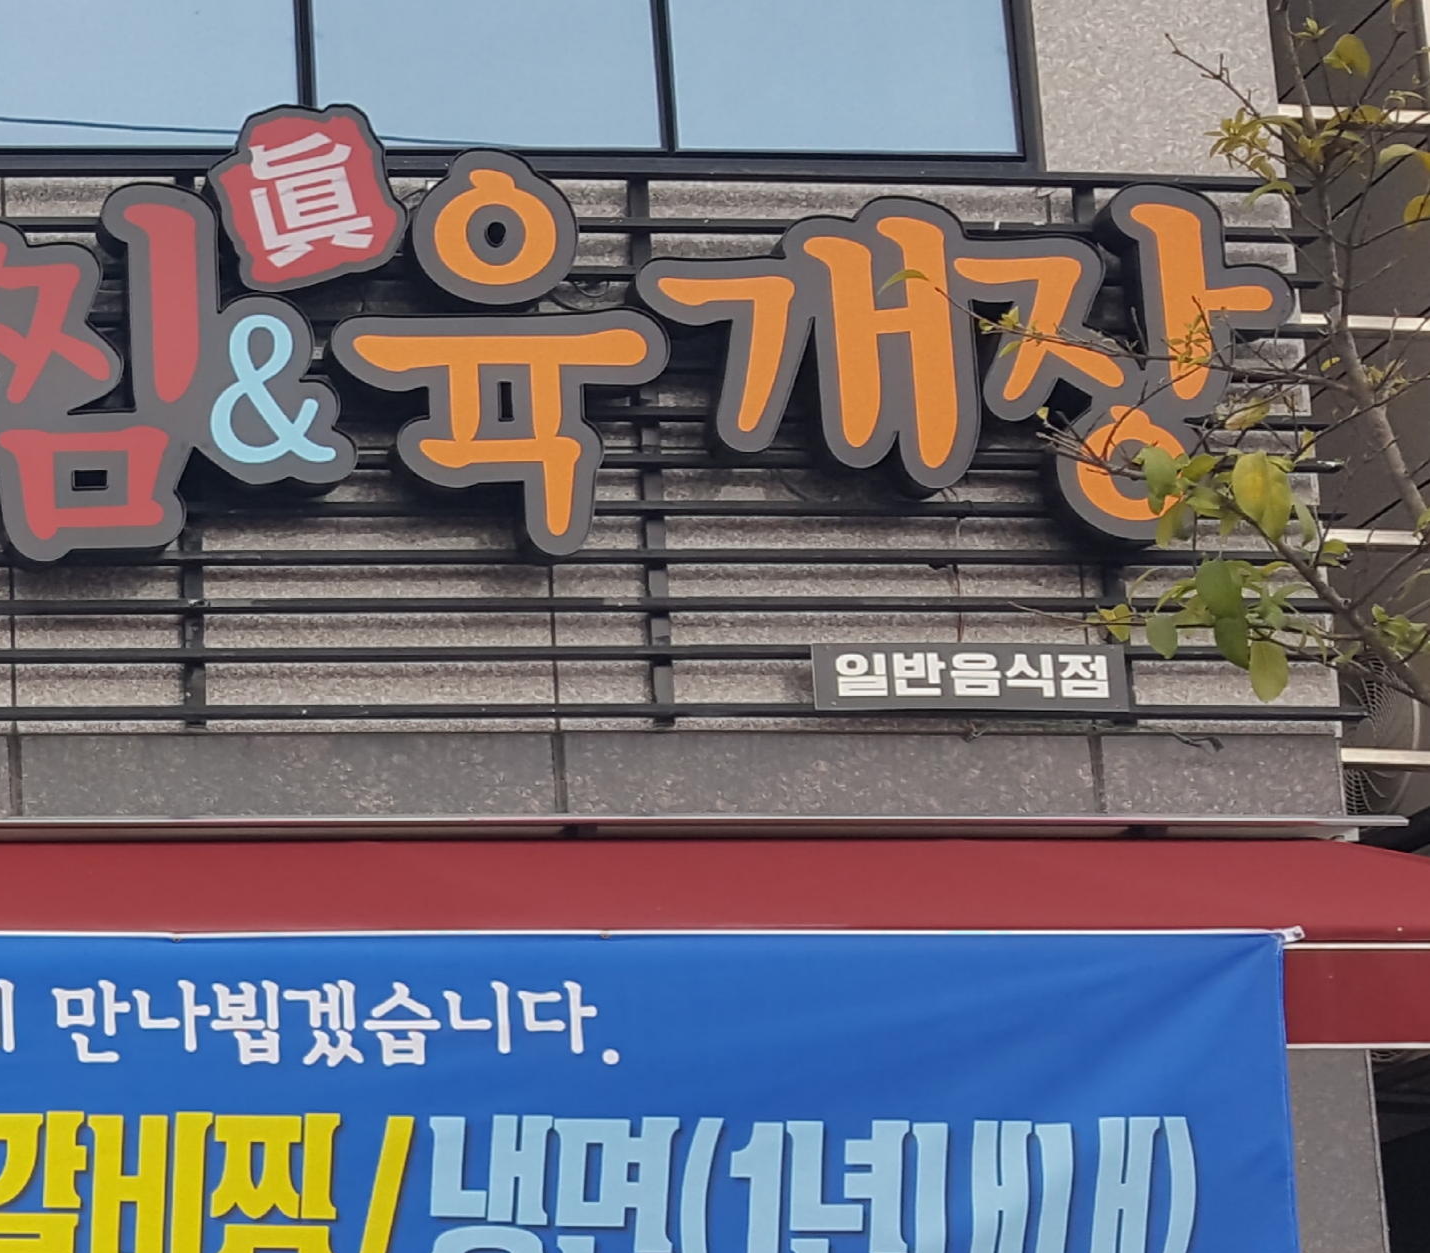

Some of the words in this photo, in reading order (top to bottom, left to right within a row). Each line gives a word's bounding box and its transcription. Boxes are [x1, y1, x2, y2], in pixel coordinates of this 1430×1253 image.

[250, 132, 373, 268] 眞
[345, 163, 1278, 541] 육개장
[834, 652, 1109, 699] 일반음식점
[52, 979, 621, 1067] 만나뵙겠습니다.
